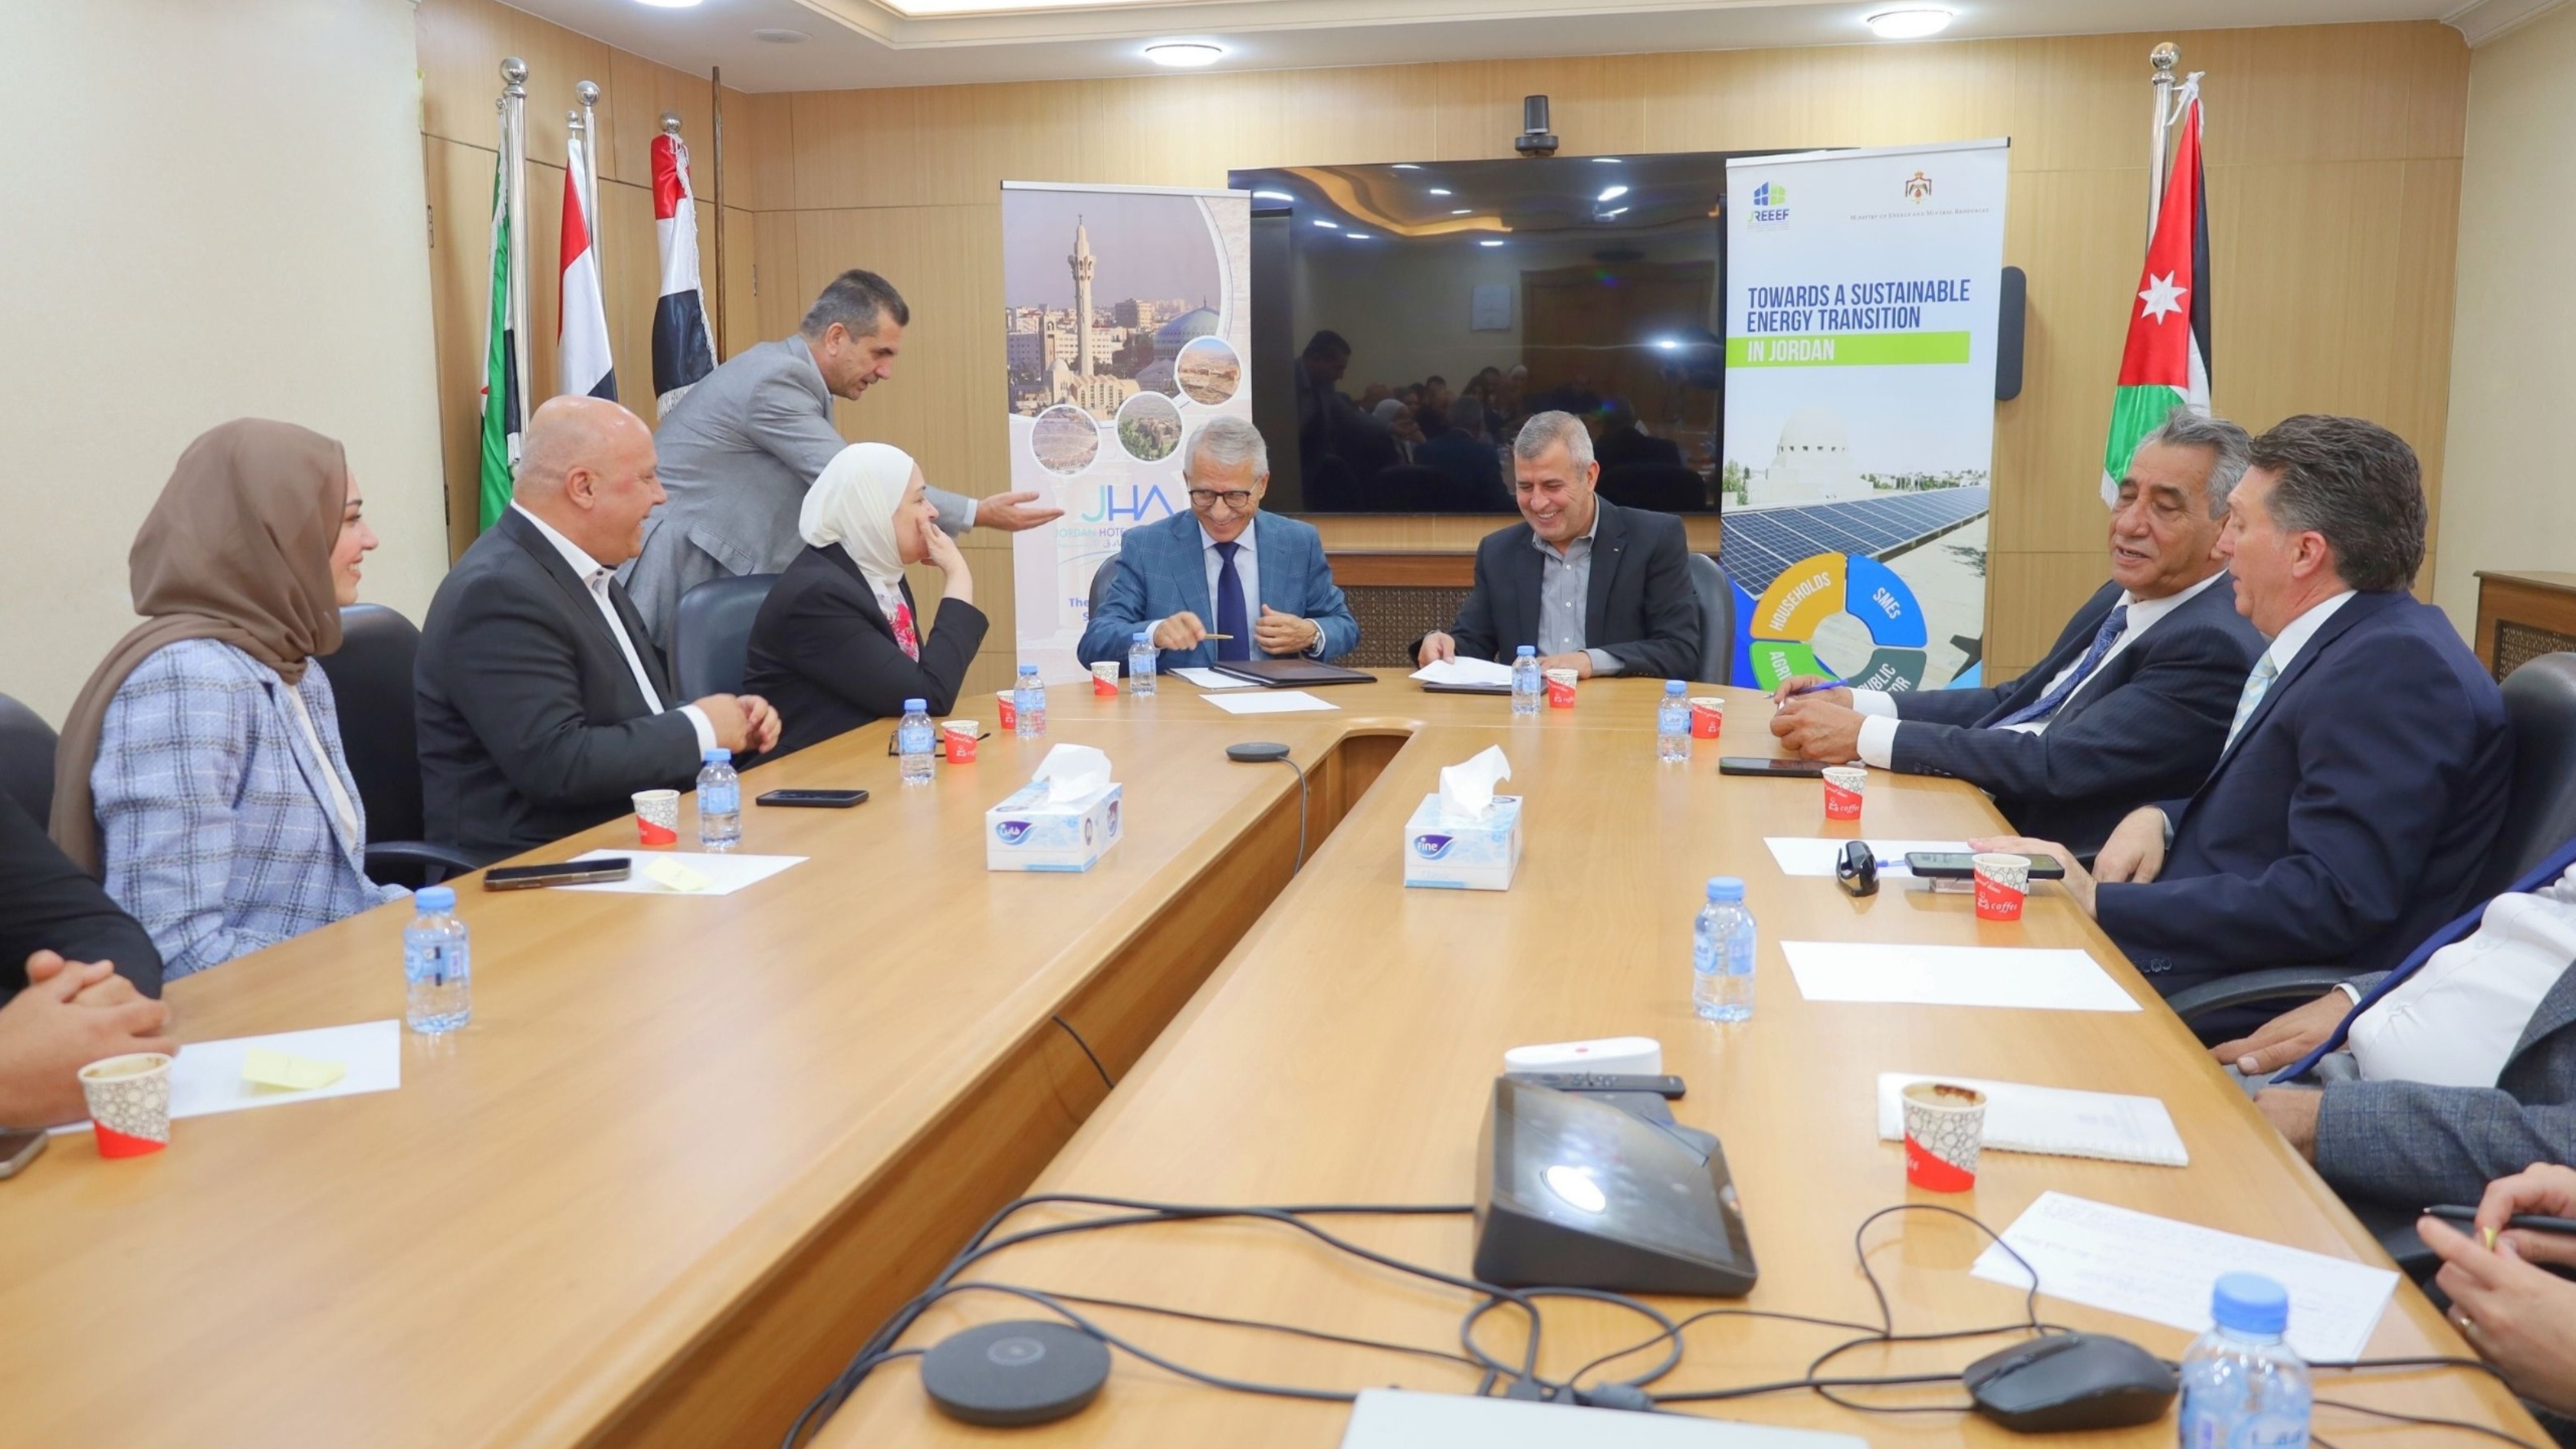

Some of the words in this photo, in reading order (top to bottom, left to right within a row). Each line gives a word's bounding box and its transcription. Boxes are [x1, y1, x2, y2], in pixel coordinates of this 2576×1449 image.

[1747, 209, 1790, 222] JREEEF
[1748, 284, 1830, 308] TOWARDS
[1835, 284, 1846, 306] A
[1851, 279, 1971, 305] SUSTAINABLE
[1747, 310, 1814, 333] ENERGY
[1818, 306, 1921, 330] TRANSITION
[1748, 340, 1764, 362] IN
[1769, 339, 1835, 361] JORDAN
[1081, 485, 1175, 523] JHA
[1769, 571, 1832, 632] HOUSEHOLDS
[1872, 587, 1901, 619] SMES
[1418, 837, 1438, 852] fine
